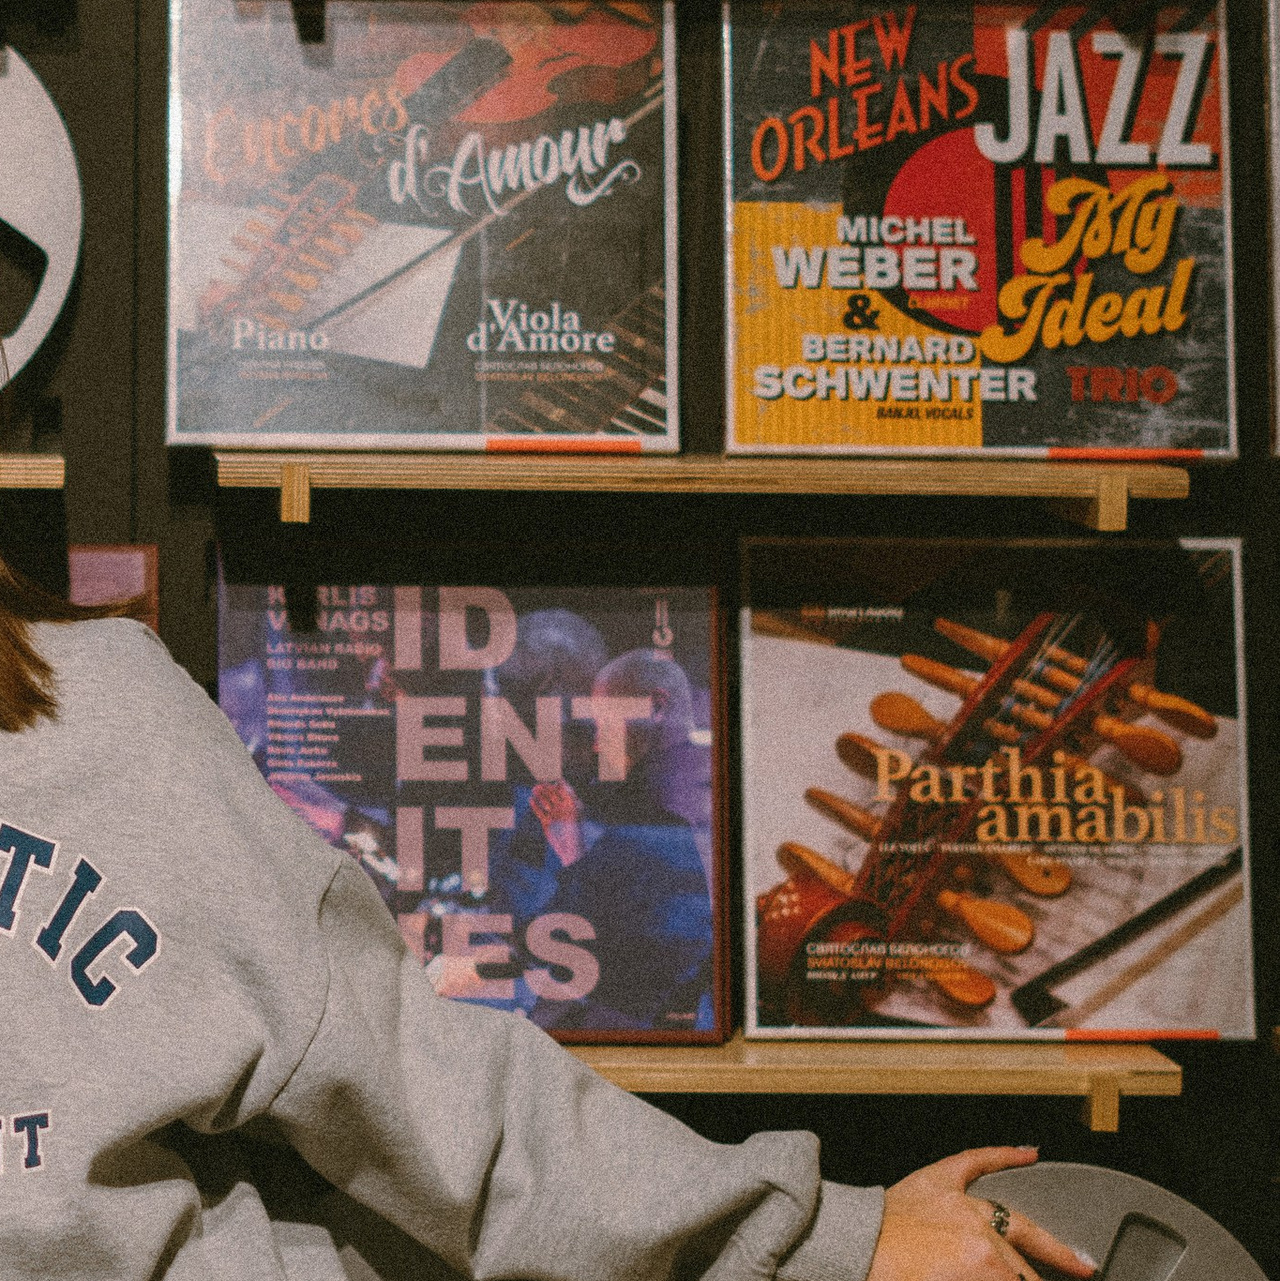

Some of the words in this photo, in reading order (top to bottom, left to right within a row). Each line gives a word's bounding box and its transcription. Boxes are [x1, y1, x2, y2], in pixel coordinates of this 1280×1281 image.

[809, 6, 917, 96] NEW
[750, 54, 980, 182] ORLEANS
[973, 23, 1213, 167] JAZZ
[836, 215, 977, 245] MICHEL
[1019, 173, 1181, 275] My
[771, 245, 980, 291] WEBER
[231, 318, 330, 351] Piano
[466, 322, 616, 353] d'Amore
[486, 298, 581, 333] Viola
[842, 294, 881, 331] &
[976, 258, 1196, 365] Ideal
[801, 334, 977, 363] BERNARD
[752, 366, 1038, 402] SCHWENTER
[1065, 365, 1179, 405] TRIO
[394, 586, 519, 670] ID
[395, 695, 652, 782] ENT
[871, 745, 1110, 805] Parthia
[975, 785, 1238, 844] amabilis
[395, 806, 515, 893] IT
